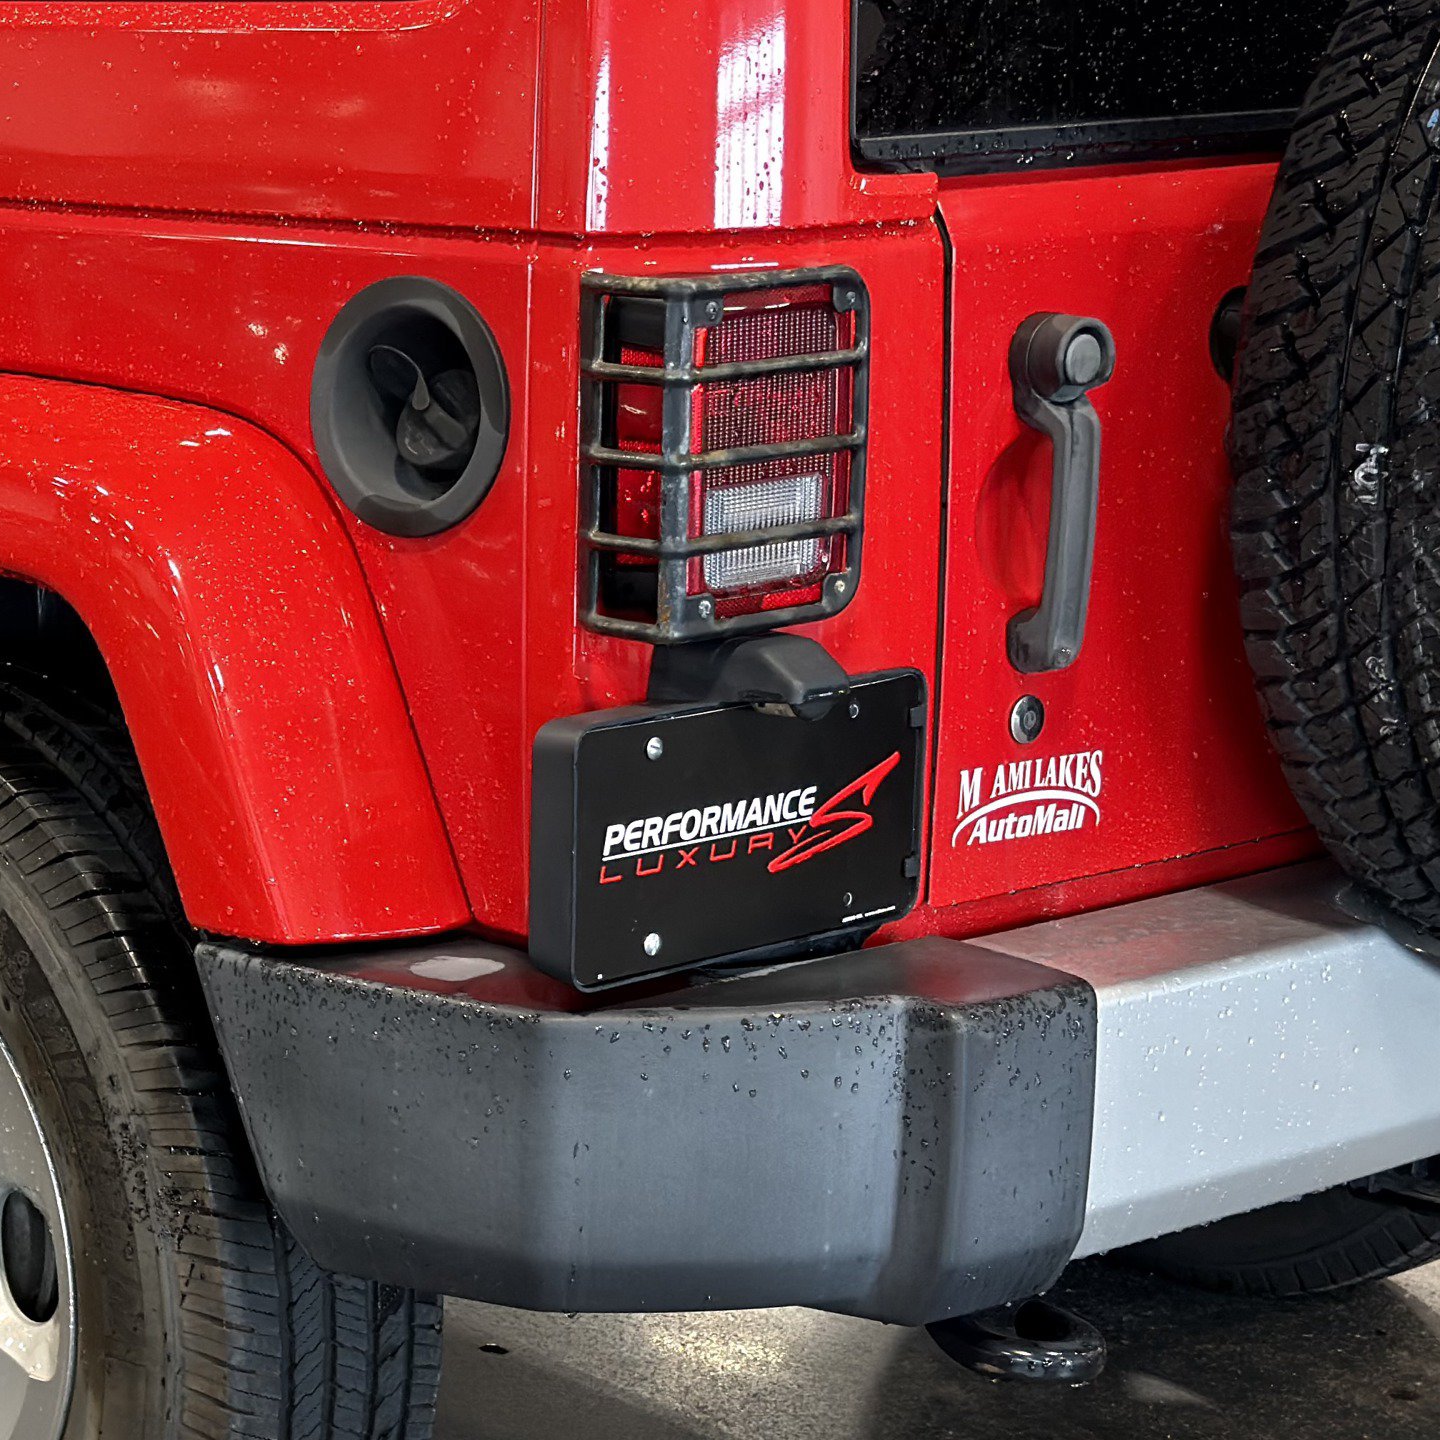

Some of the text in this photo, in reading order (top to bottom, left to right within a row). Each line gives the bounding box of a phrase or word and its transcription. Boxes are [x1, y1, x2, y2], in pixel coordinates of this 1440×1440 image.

[956, 750, 1103, 819] MAMI LAKES
[603, 785, 818, 858] PERFORMANCE
[966, 803, 1086, 846] AutoMall
